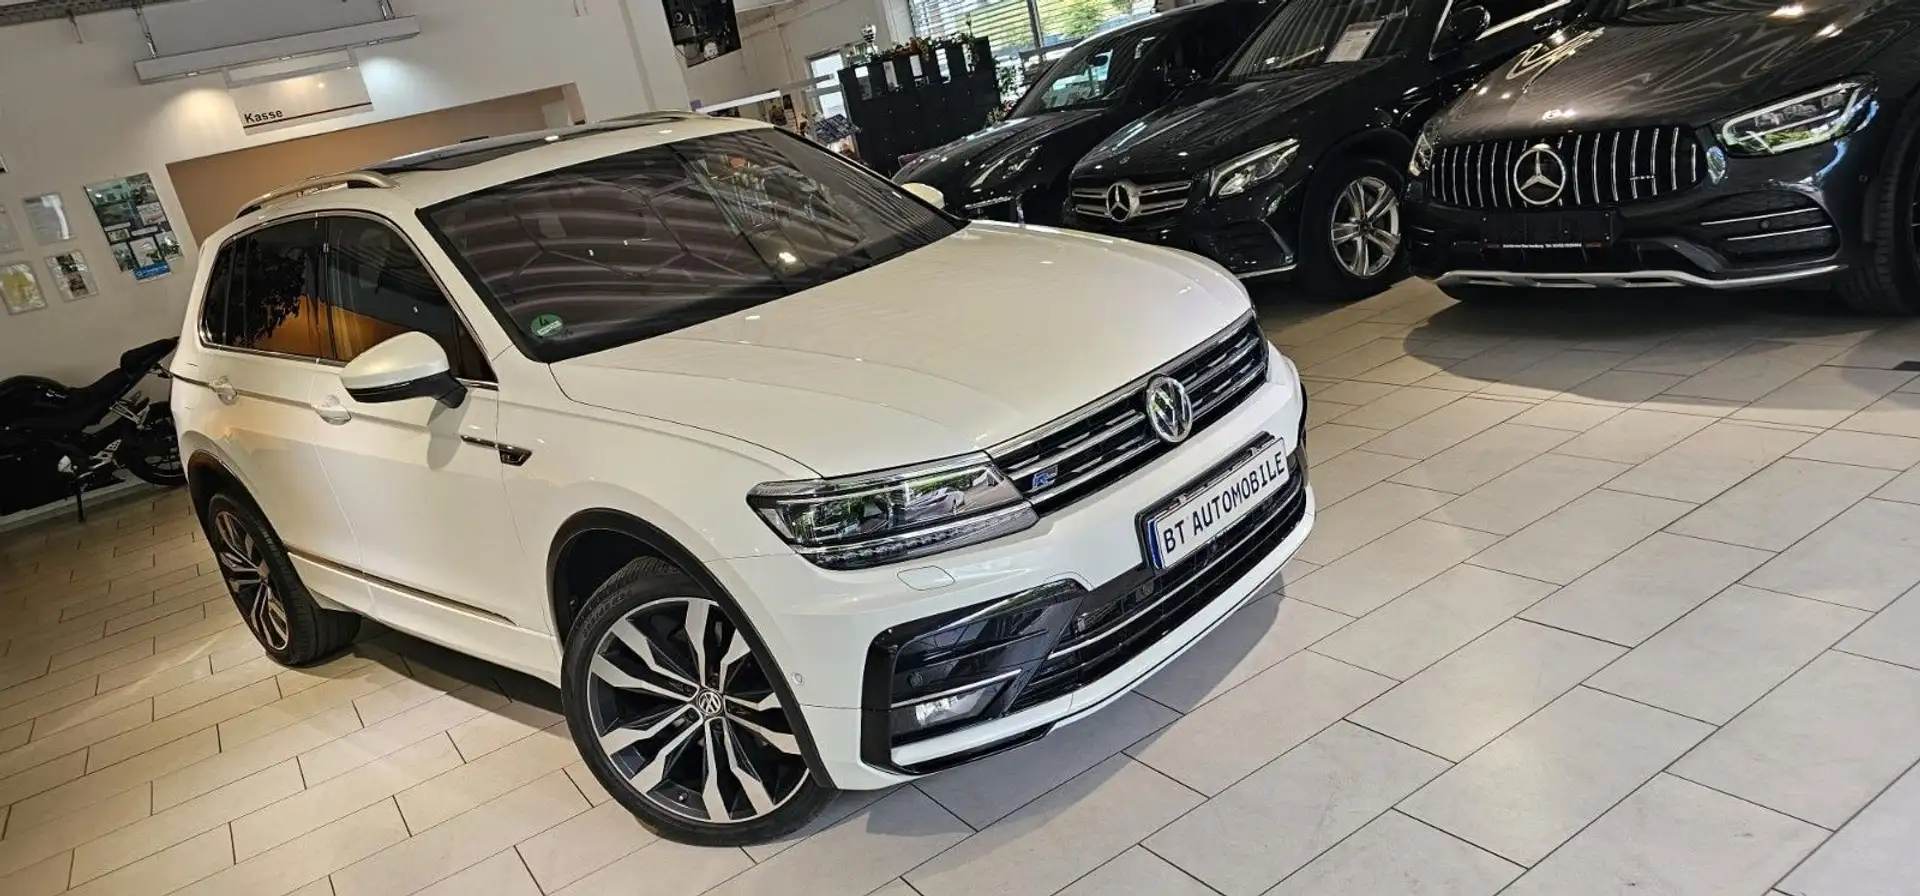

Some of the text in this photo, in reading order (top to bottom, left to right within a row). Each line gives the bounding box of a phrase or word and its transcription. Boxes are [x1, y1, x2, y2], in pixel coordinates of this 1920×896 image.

[244, 109, 283, 124] Kasse
[1163, 451, 1285, 553] BT AUTOMOBILE
